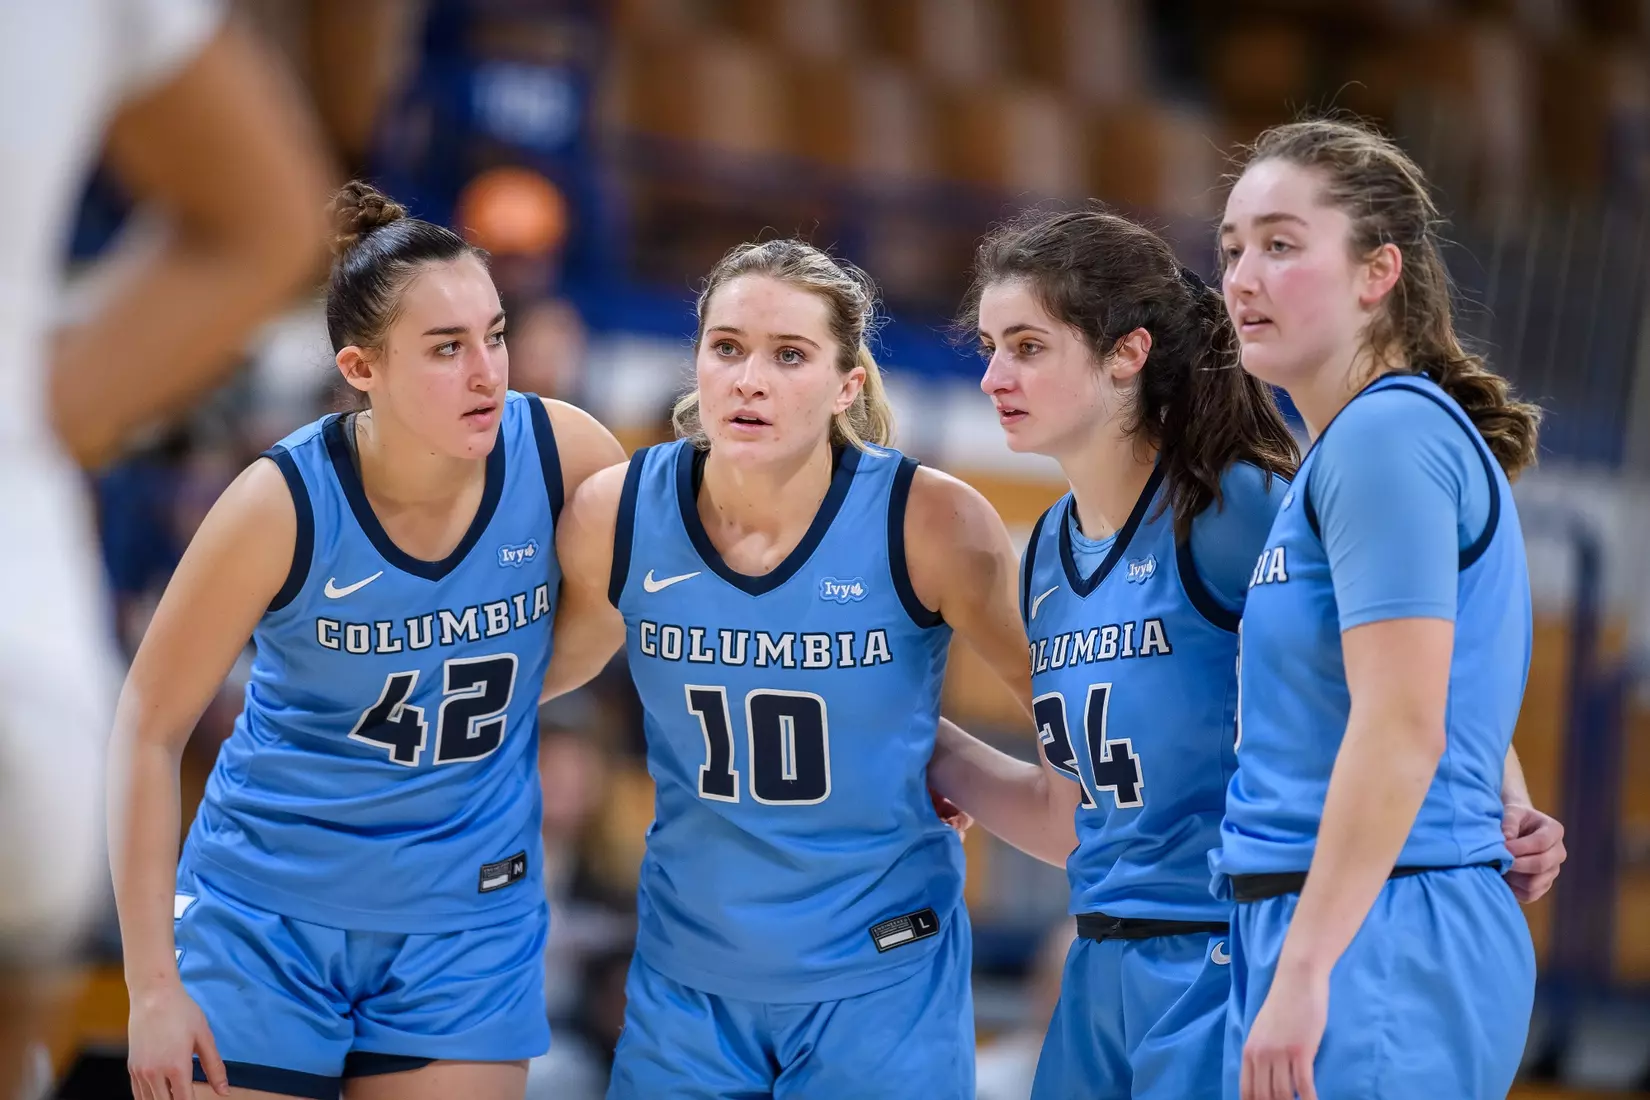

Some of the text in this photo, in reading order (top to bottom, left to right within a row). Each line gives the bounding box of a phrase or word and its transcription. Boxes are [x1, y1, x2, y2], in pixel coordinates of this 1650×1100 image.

[316, 583, 551, 654] COLUMBIA
[825, 581, 851, 598] Ivy
[639, 619, 893, 669] COLUMBIA
[347, 652, 519, 767] 42
[684, 683, 831, 806] 10
